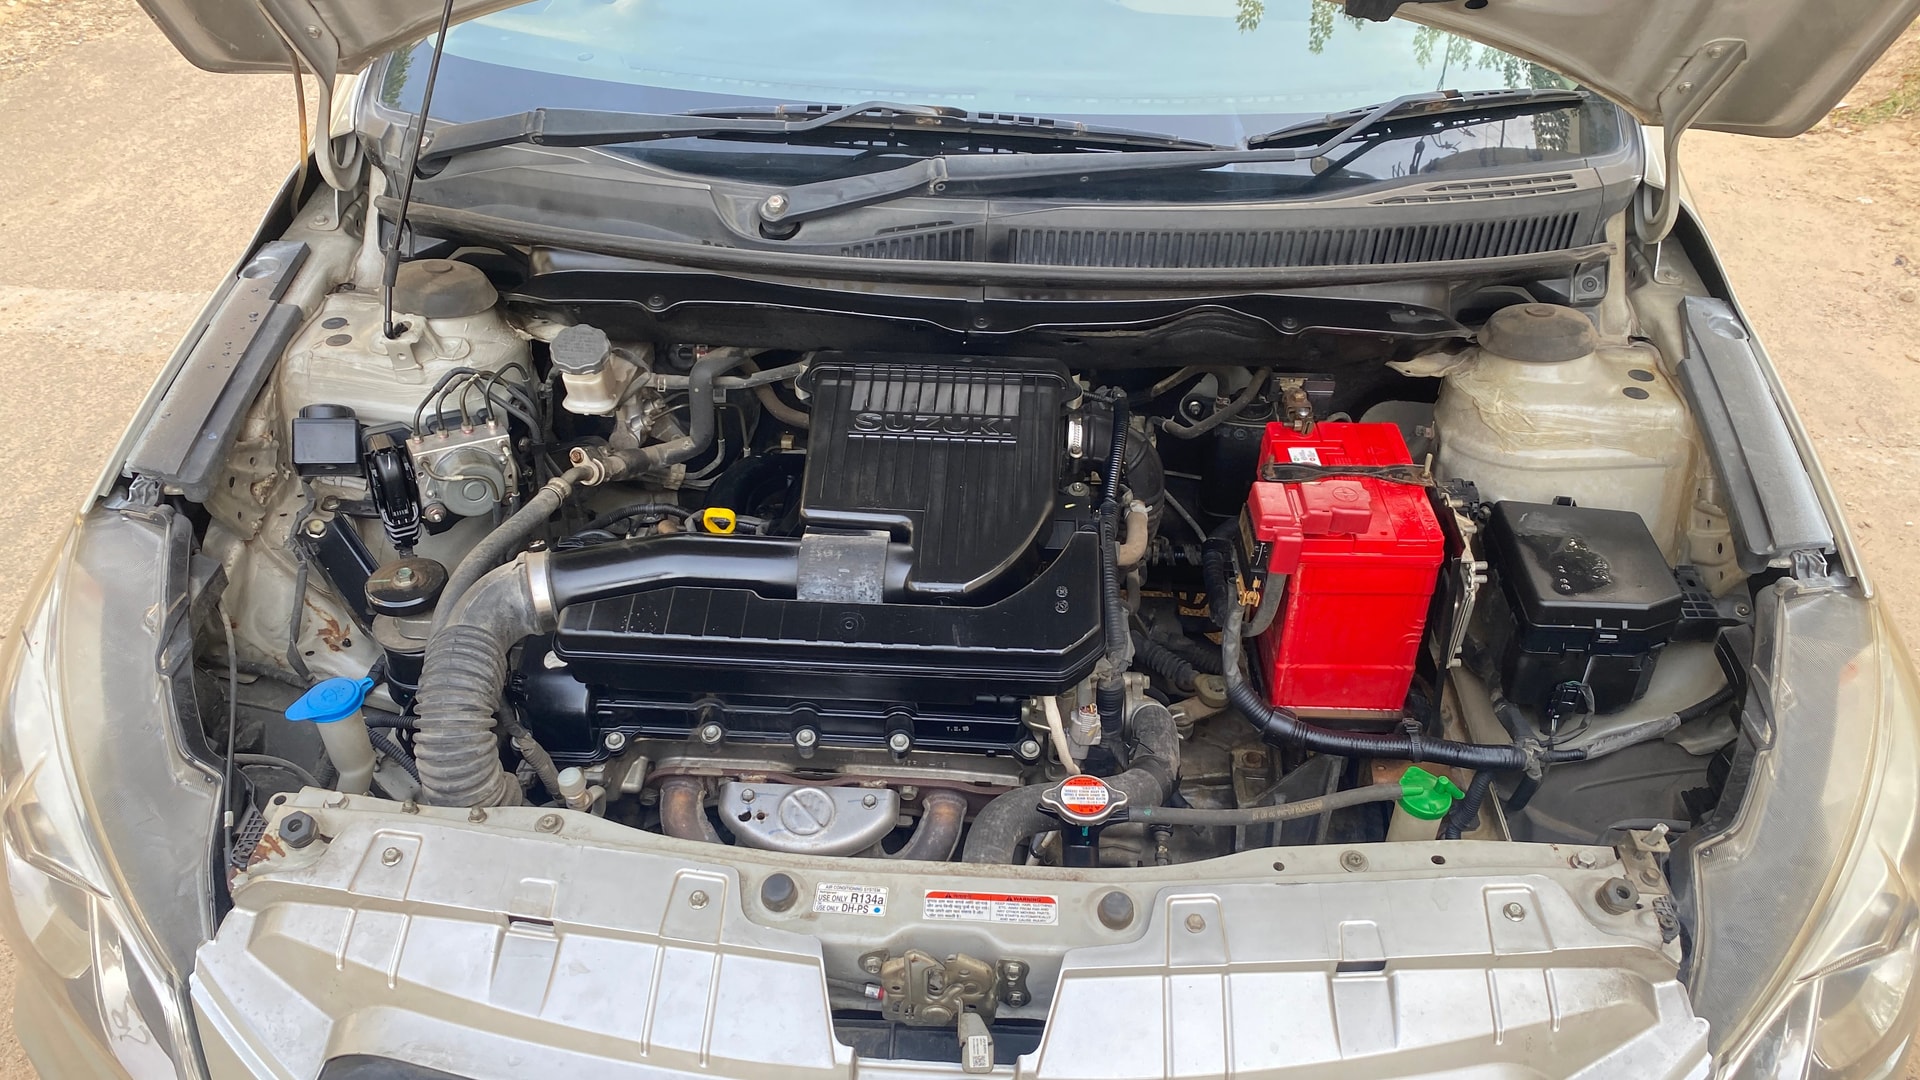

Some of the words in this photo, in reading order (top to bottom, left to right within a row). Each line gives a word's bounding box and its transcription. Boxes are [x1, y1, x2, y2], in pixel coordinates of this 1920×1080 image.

[853, 412, 1012, 436] SUZUKI
[851, 893, 884, 904] R134a
[842, 904, 869, 913] DH-PS
